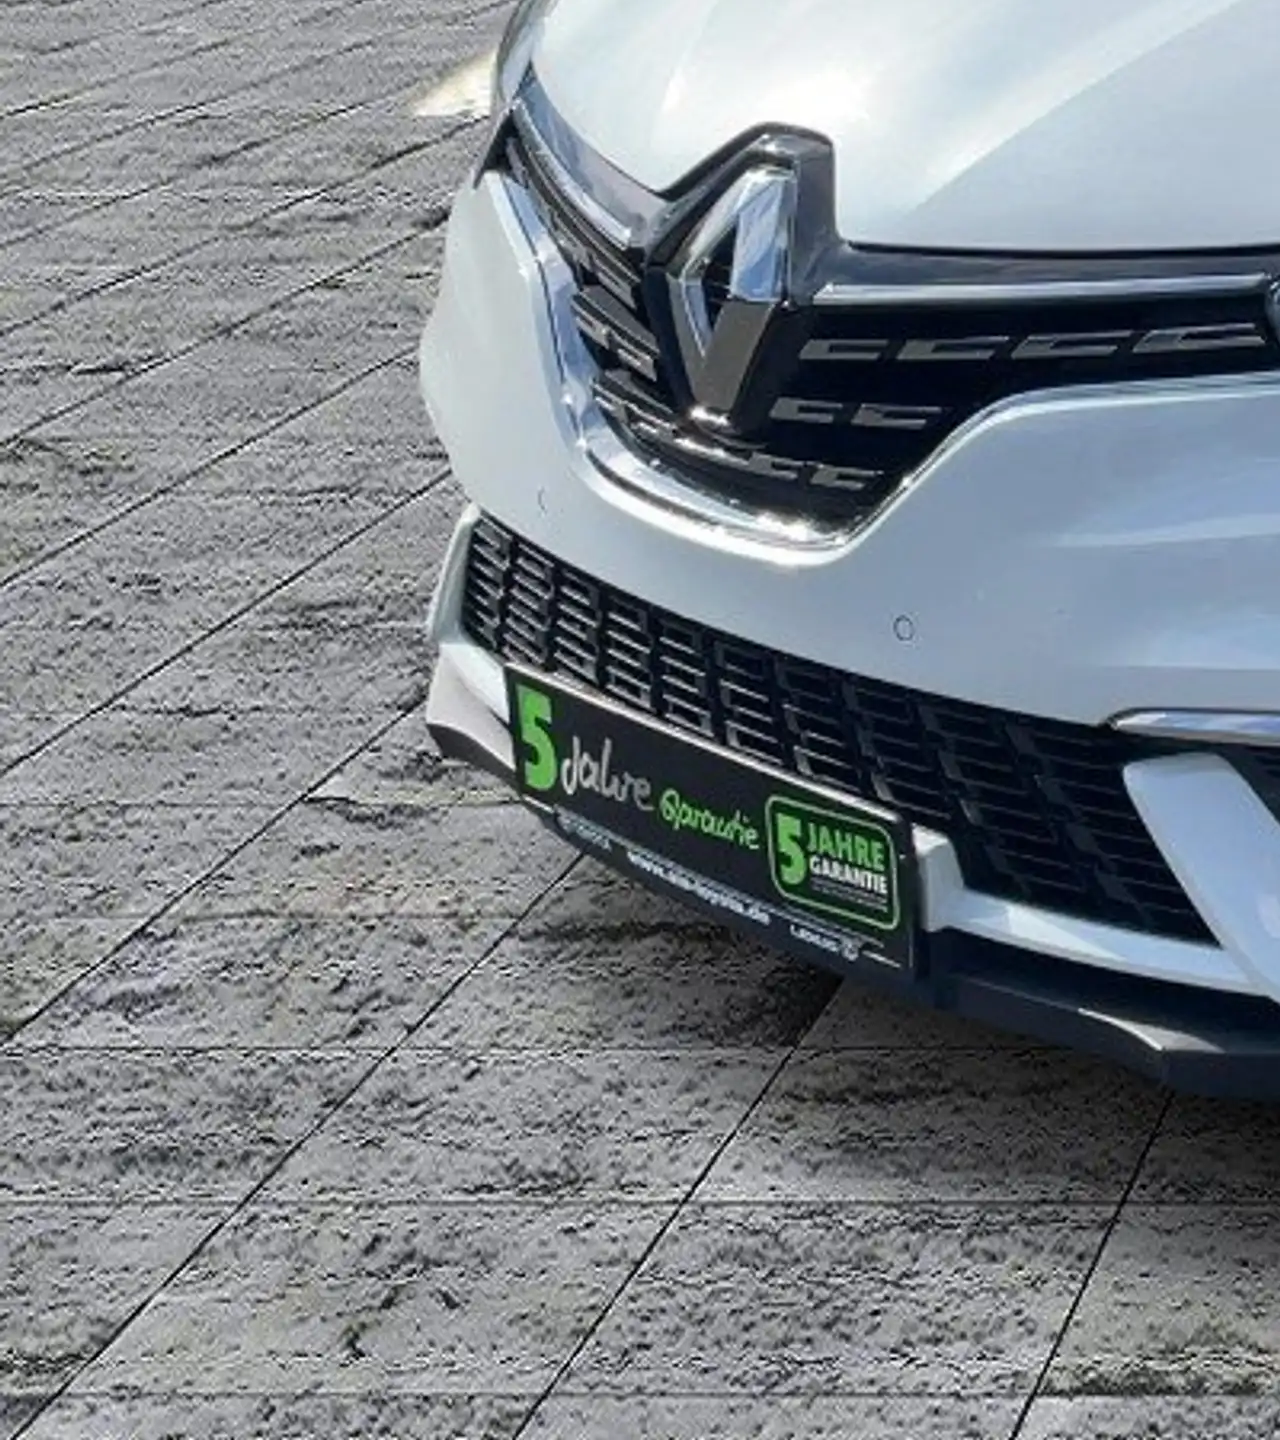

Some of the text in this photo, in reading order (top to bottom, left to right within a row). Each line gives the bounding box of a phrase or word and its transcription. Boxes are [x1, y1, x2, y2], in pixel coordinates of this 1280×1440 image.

[515, 682, 559, 792] 5
[776, 811, 886, 886] 5 JAHRE
[809, 854, 889, 895] GARANTIE
